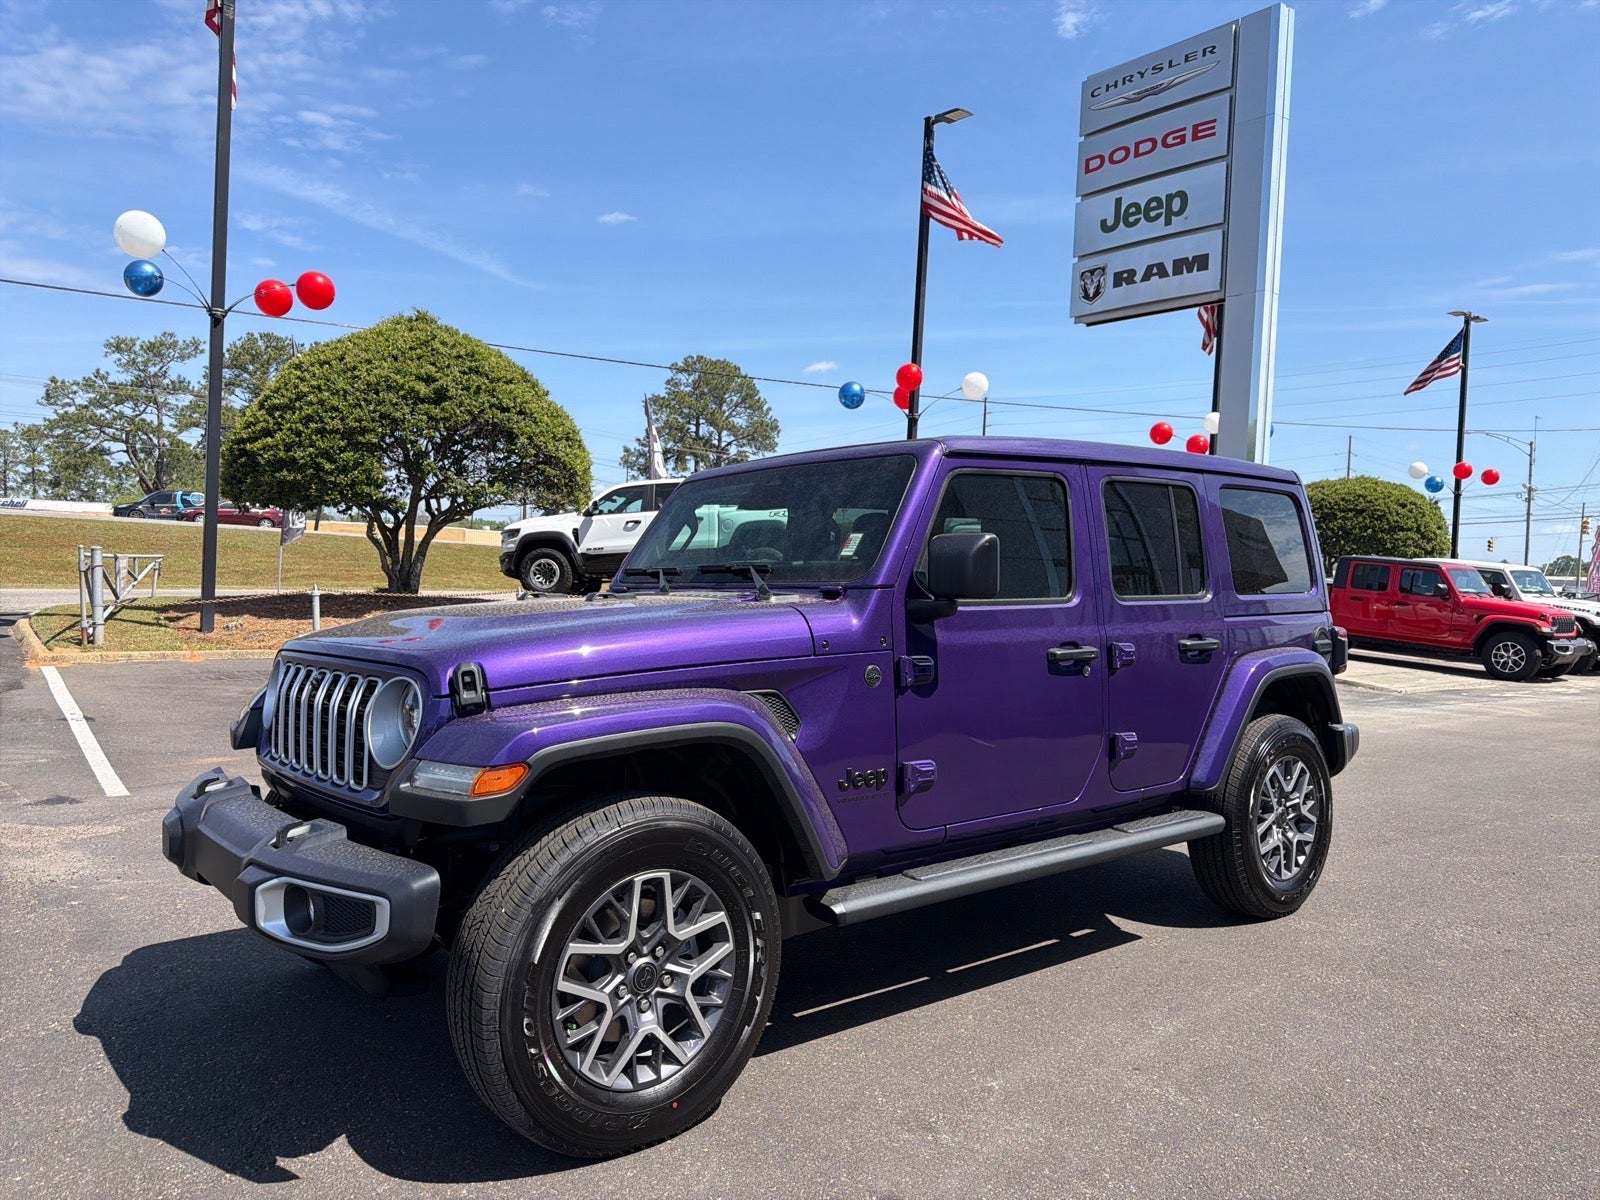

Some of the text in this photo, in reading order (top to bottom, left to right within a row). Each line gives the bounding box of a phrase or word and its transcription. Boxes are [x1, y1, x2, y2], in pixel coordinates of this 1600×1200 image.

[1090, 45, 1218, 98] CHRYSLER
[1084, 118, 1217, 175] DODGE
[1100, 189, 1189, 234] Jeep
[1112, 252, 1210, 289] RAM
[837, 767, 889, 793] Jeep
